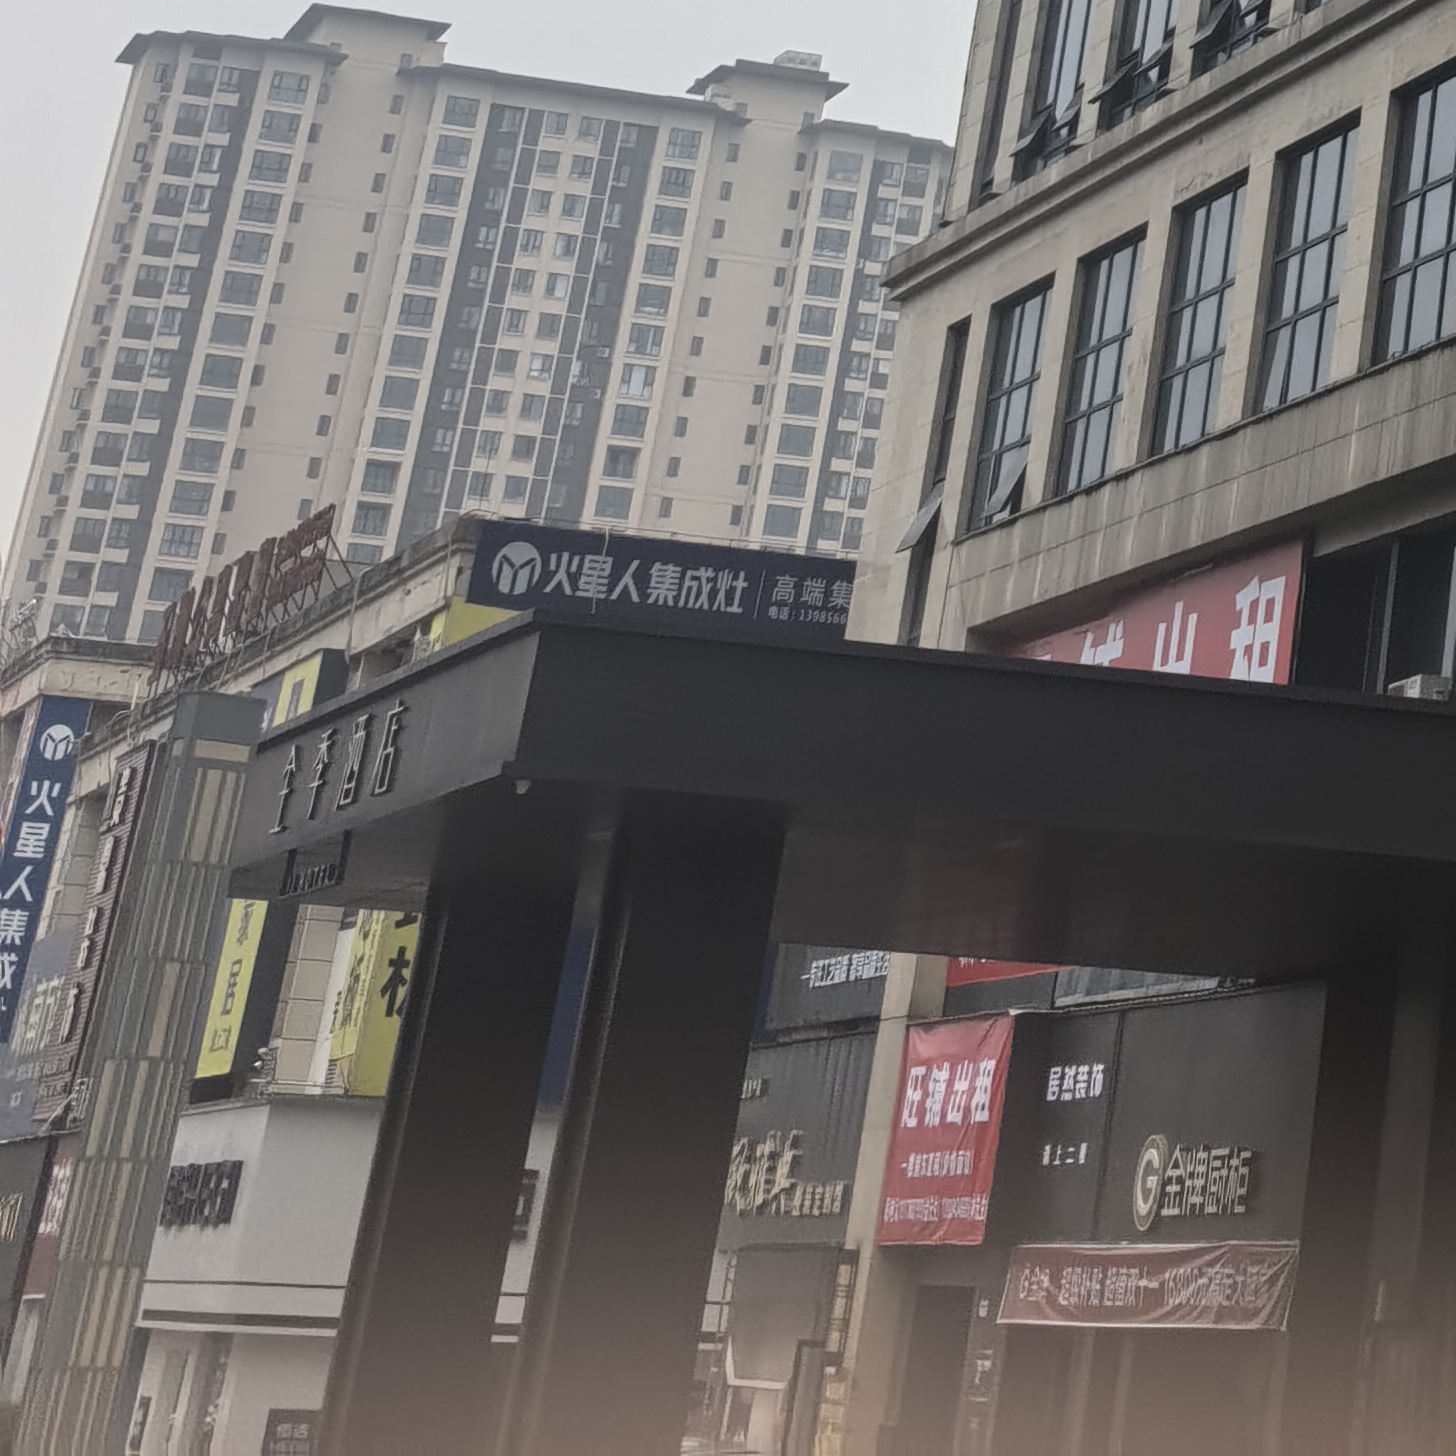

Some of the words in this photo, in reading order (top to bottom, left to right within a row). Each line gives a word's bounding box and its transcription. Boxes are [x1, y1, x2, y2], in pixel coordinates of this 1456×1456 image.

[543, 549, 750, 615] 火星人集成灶
[268, 698, 404, 835] 全季酒店
[0, 779, 61, 1012] 火星人集成
[901, 1057, 996, 1129] 旺铺出租
[1161, 1143, 1254, 1218] 金牌厨柜
